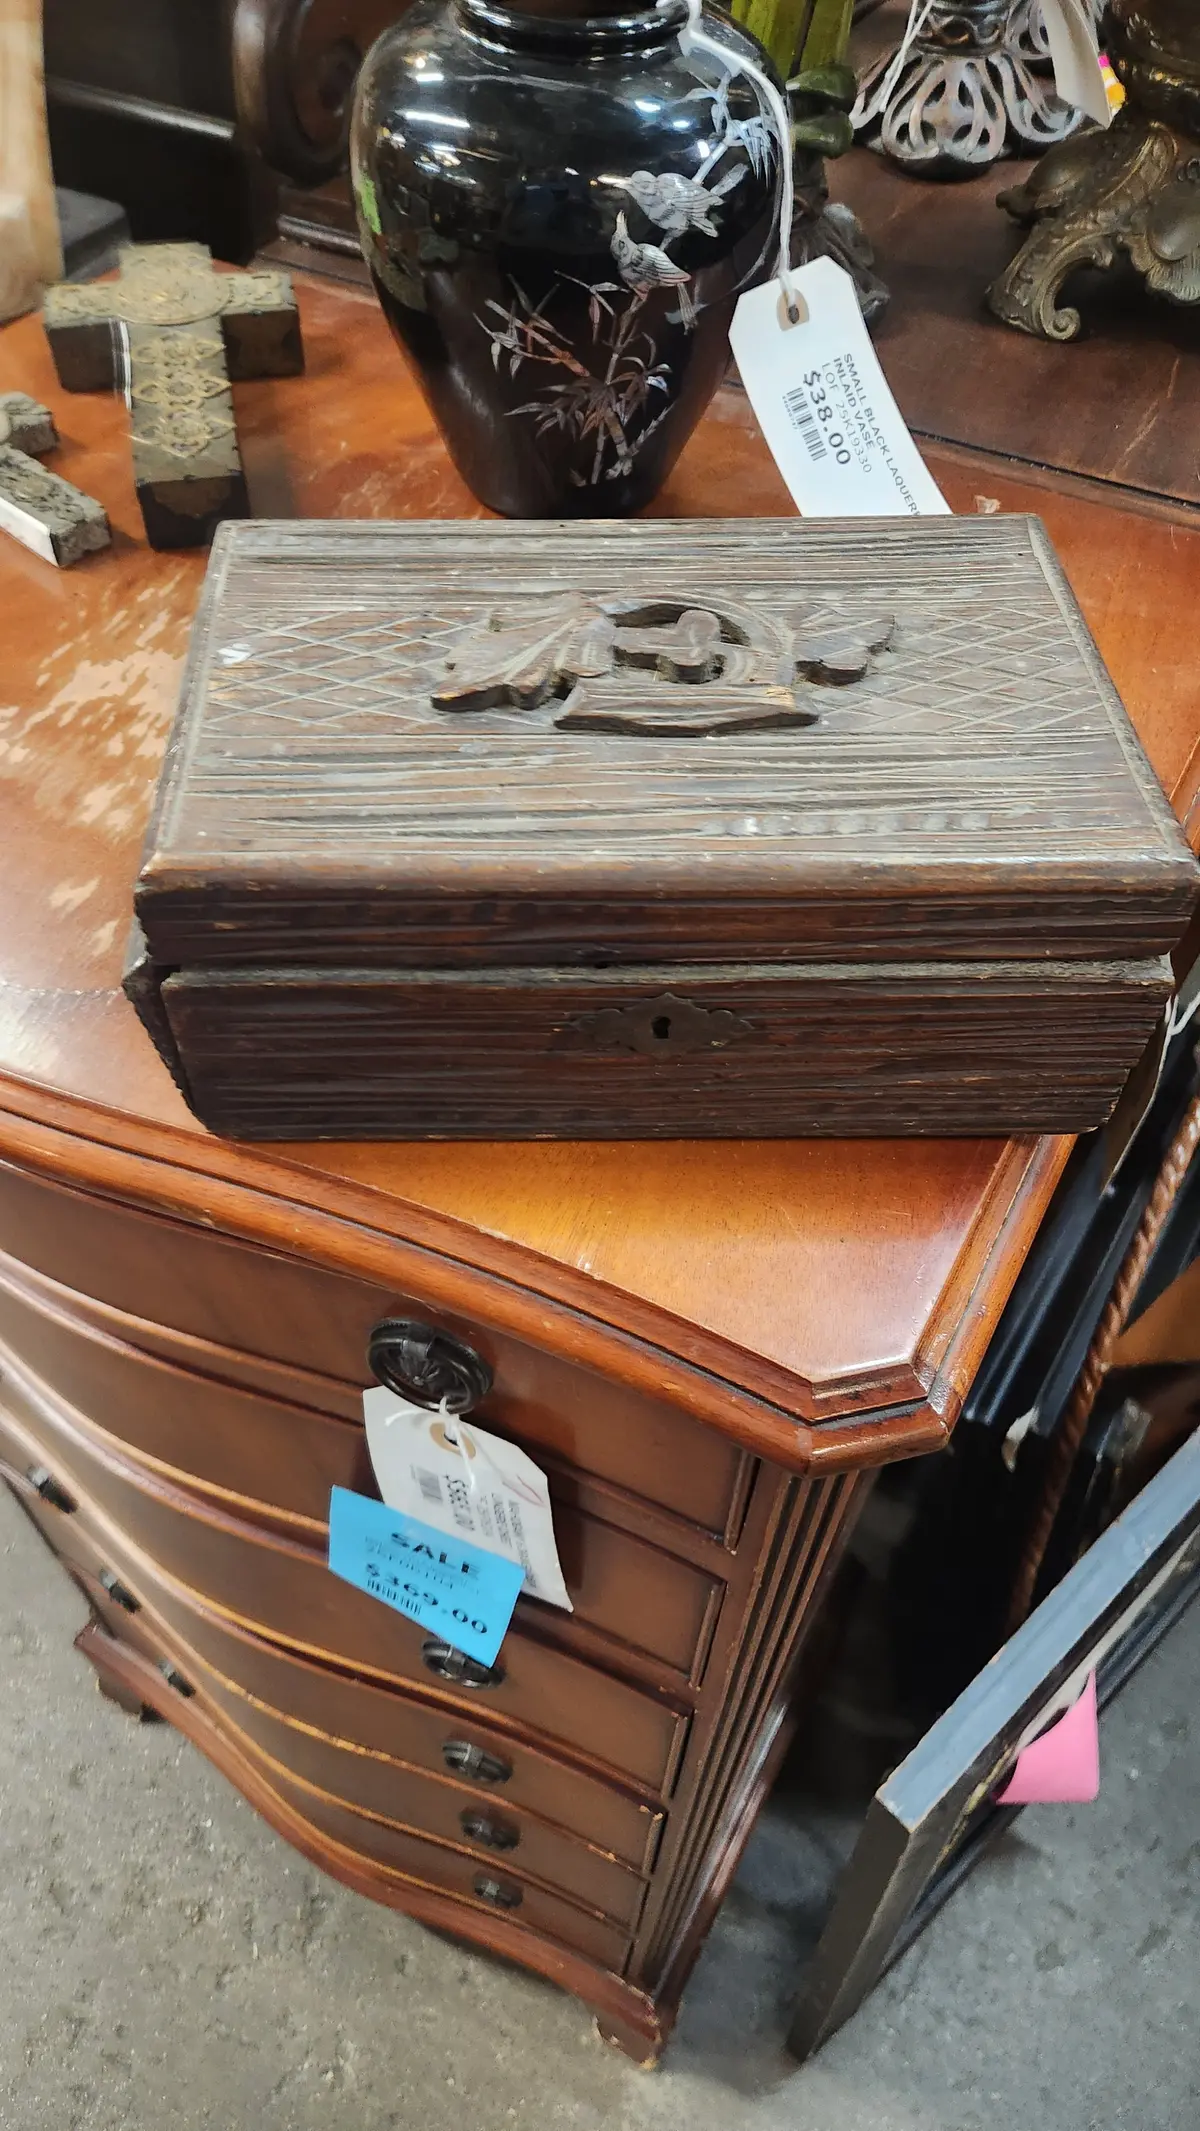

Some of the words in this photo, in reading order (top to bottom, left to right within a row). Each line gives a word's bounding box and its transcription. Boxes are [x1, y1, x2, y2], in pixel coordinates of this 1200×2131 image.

[803, 370, 851, 464] $38.00
[833, 357, 857, 407] INLAID
[854, 411, 876, 449] VASE
[836, 401, 872, 473] 25K19330
[844, 353, 868, 406] SMALL
[864, 407, 890, 455] BLACK
[391, 1532, 481, 1579] SALE
[366, 1564, 487, 1633] $369.00
